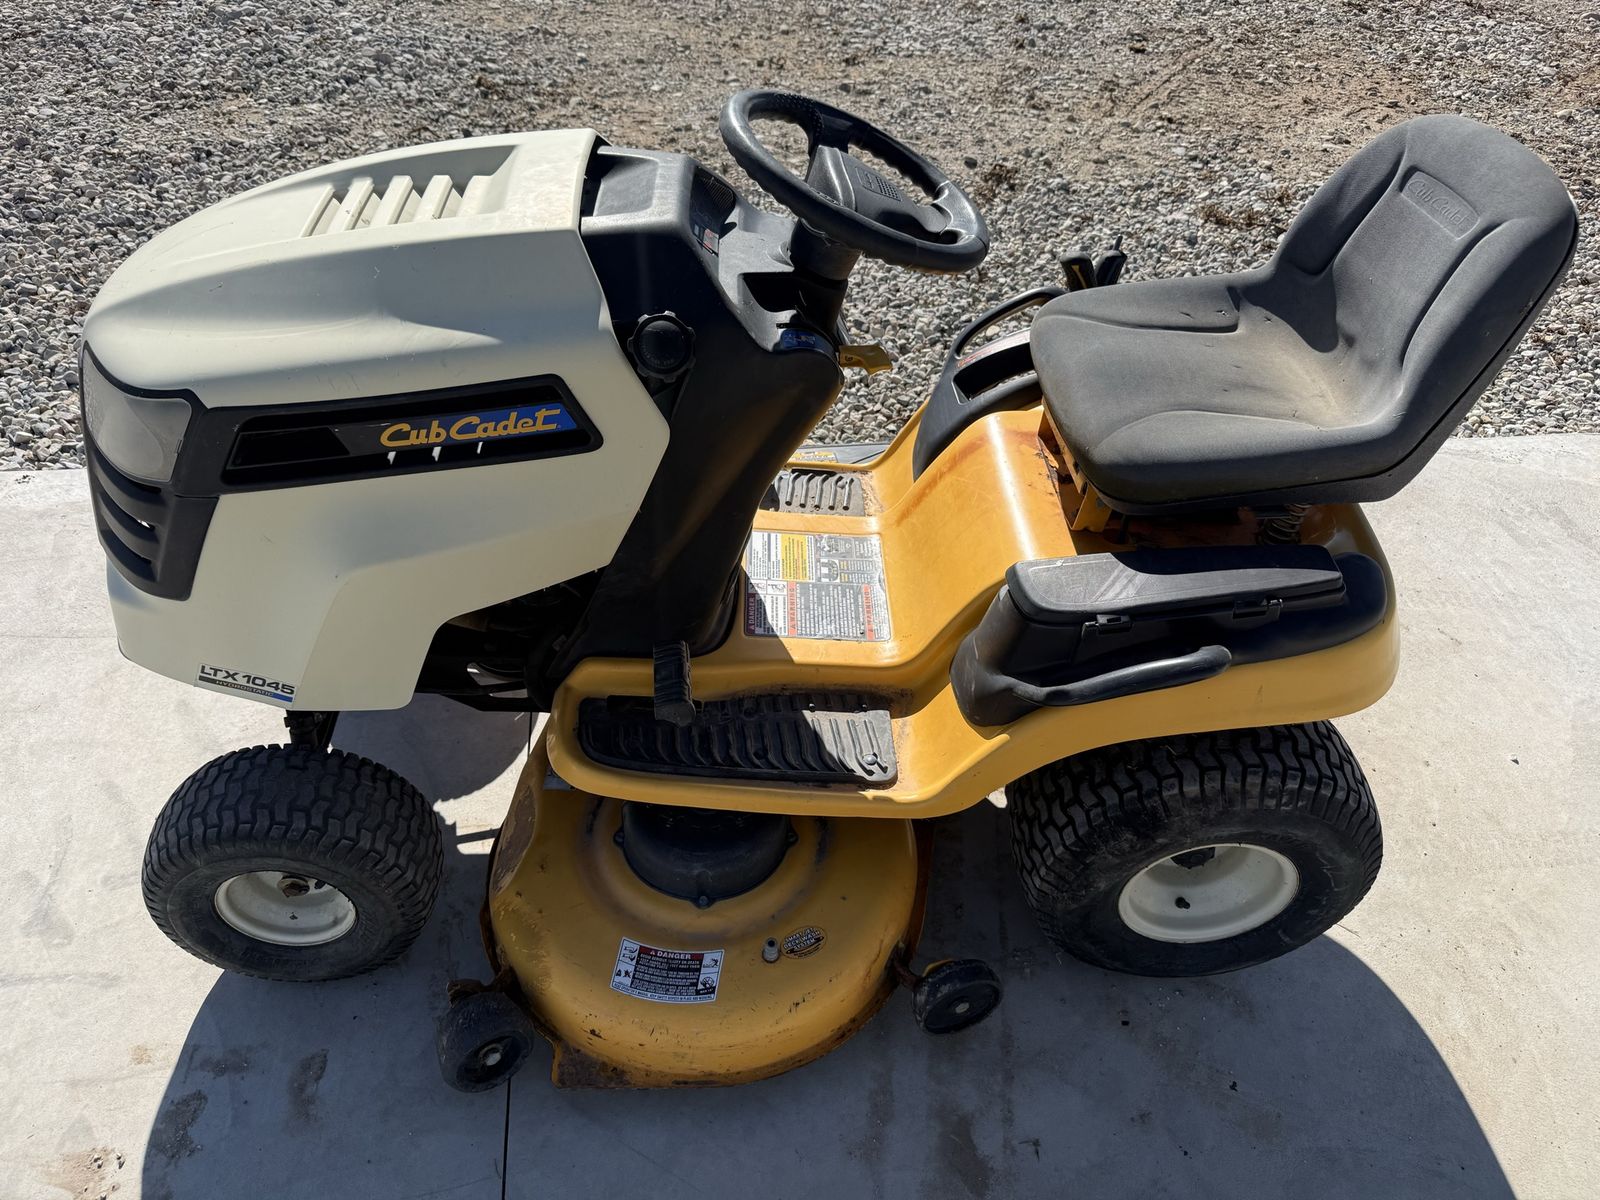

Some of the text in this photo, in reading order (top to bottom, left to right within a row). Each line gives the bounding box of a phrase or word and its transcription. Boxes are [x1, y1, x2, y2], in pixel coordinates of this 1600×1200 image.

[379, 408, 561, 448] Cub Cadet
[748, 597, 756, 624] DANGER
[200, 665, 296, 695] LTX 1045
[215, 680, 275, 697] HYDROSTATIC
[656, 950, 691, 960] DANGER
